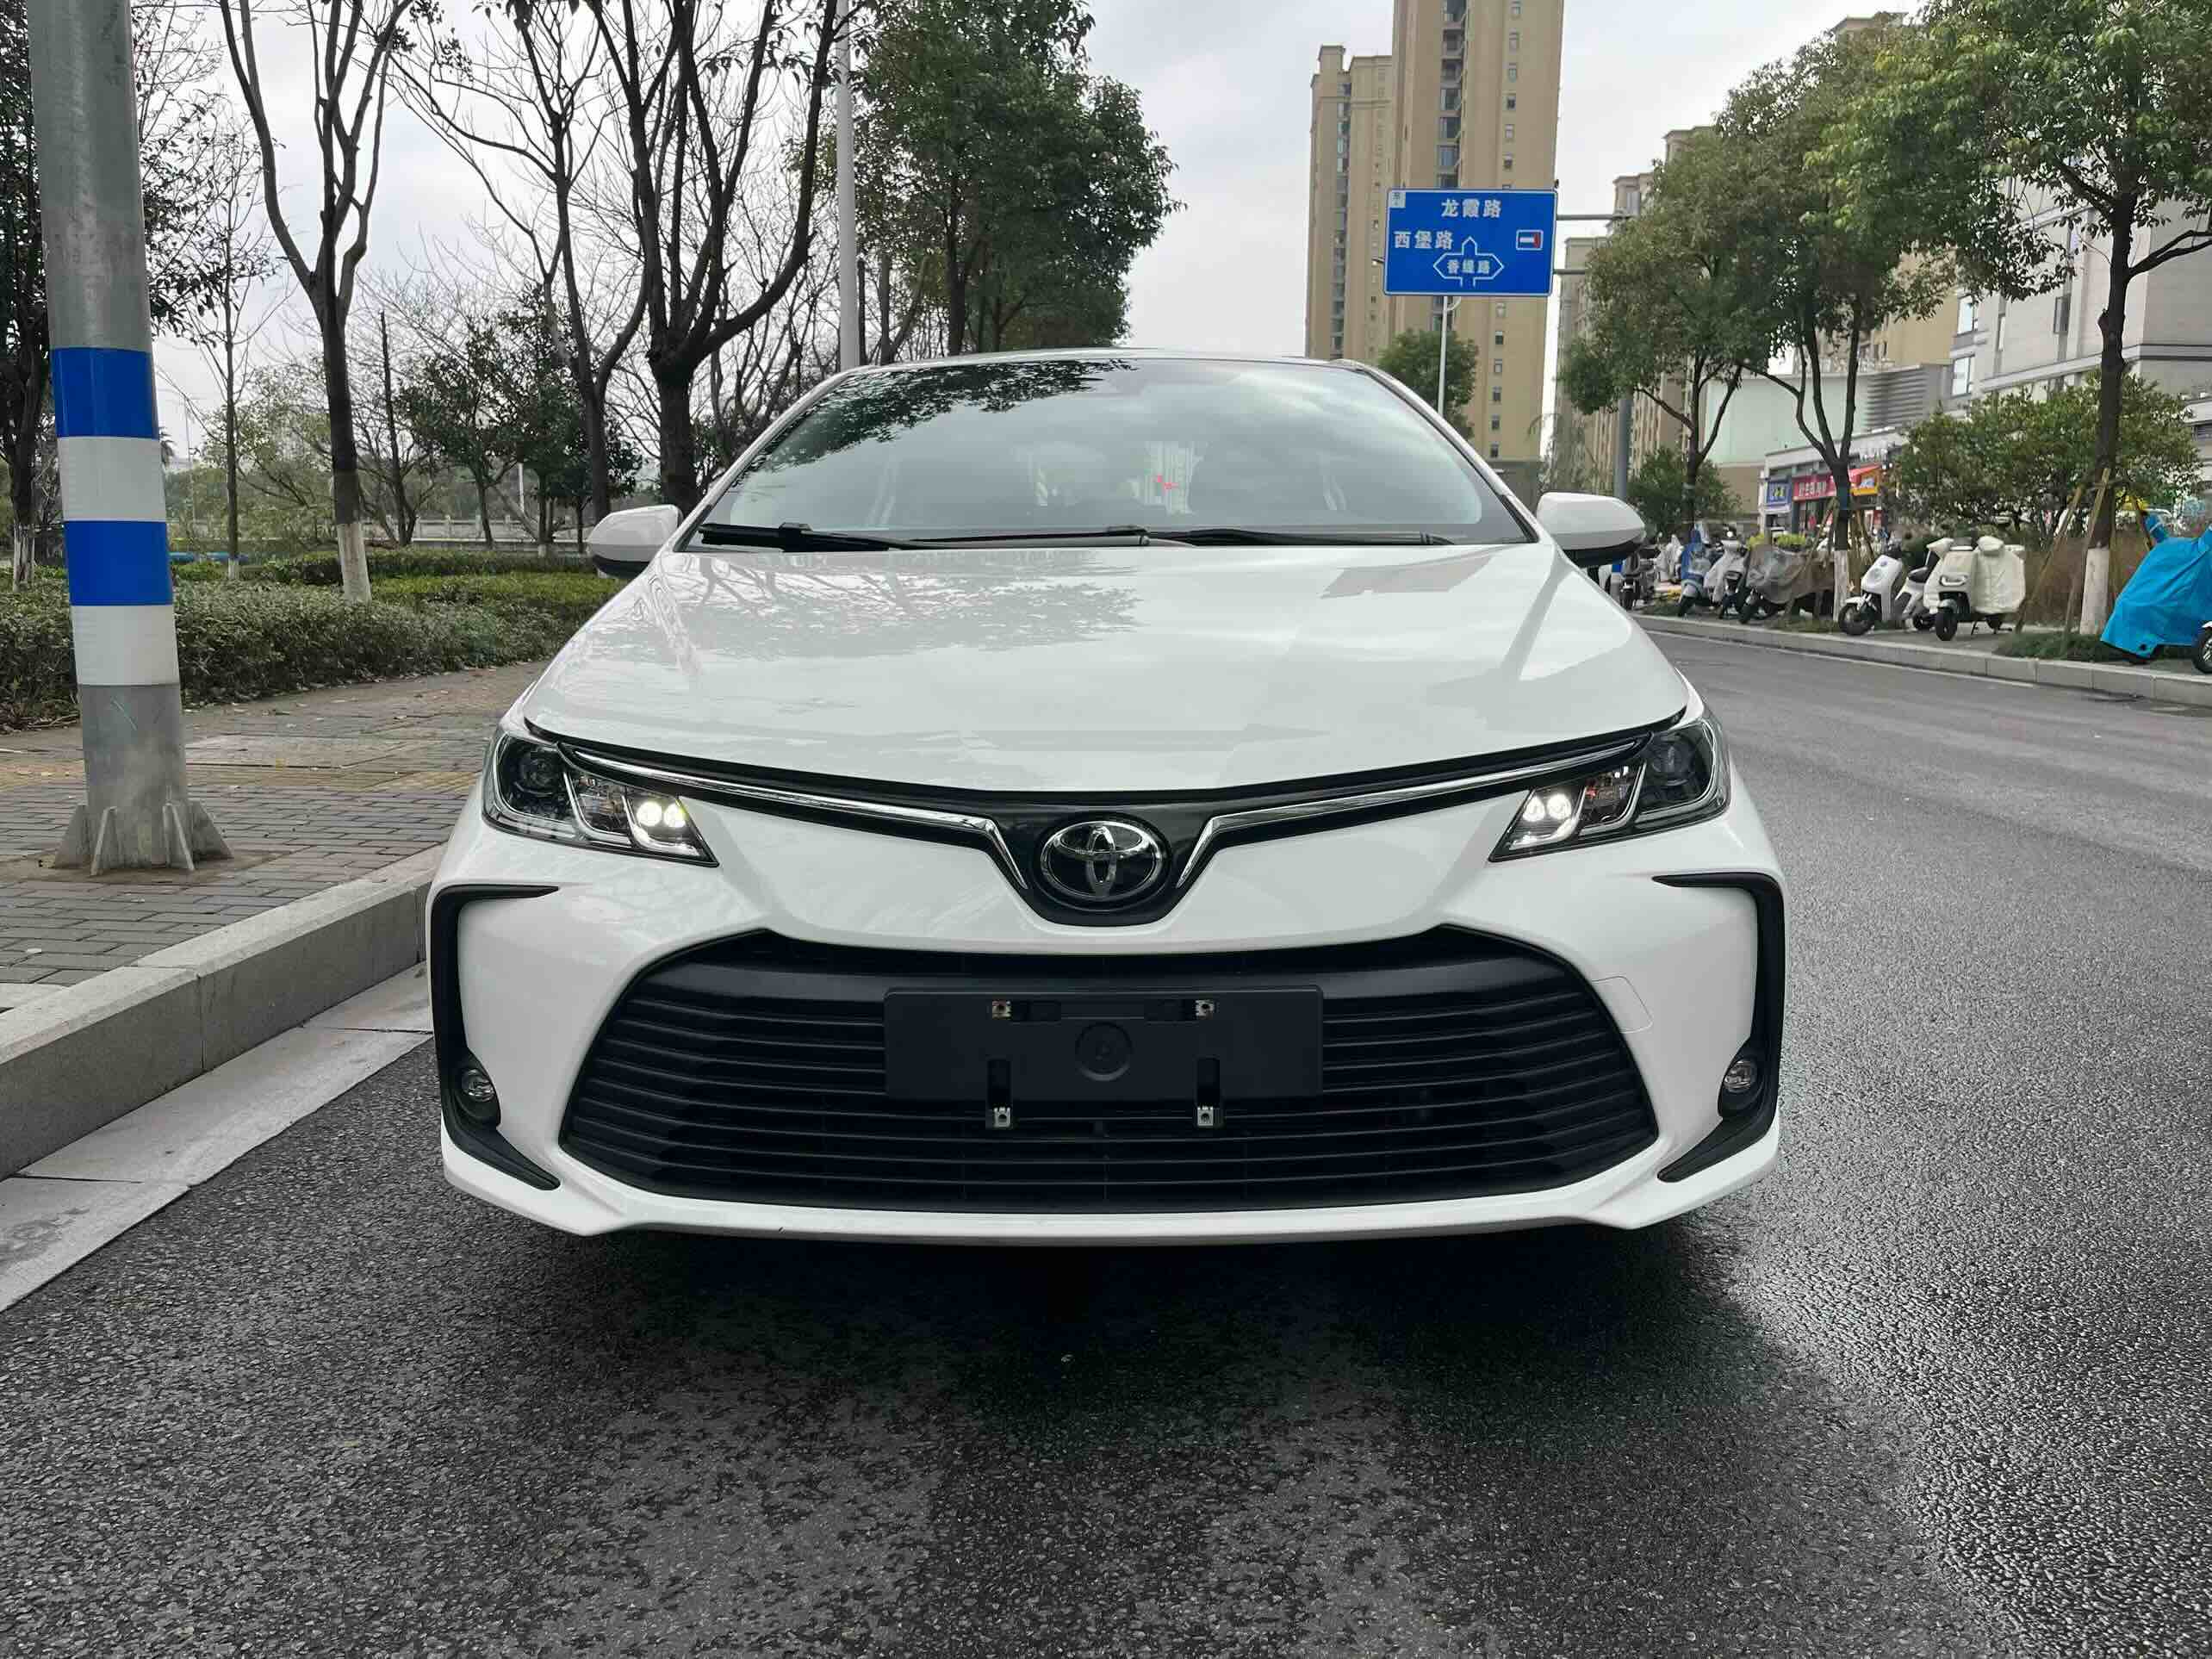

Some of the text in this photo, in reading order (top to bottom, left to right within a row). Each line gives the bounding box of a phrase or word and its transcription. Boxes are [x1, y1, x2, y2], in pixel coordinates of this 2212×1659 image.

[1441, 198, 1501, 218] 龙霞路
[1394, 230, 1454, 250] 西堡路
